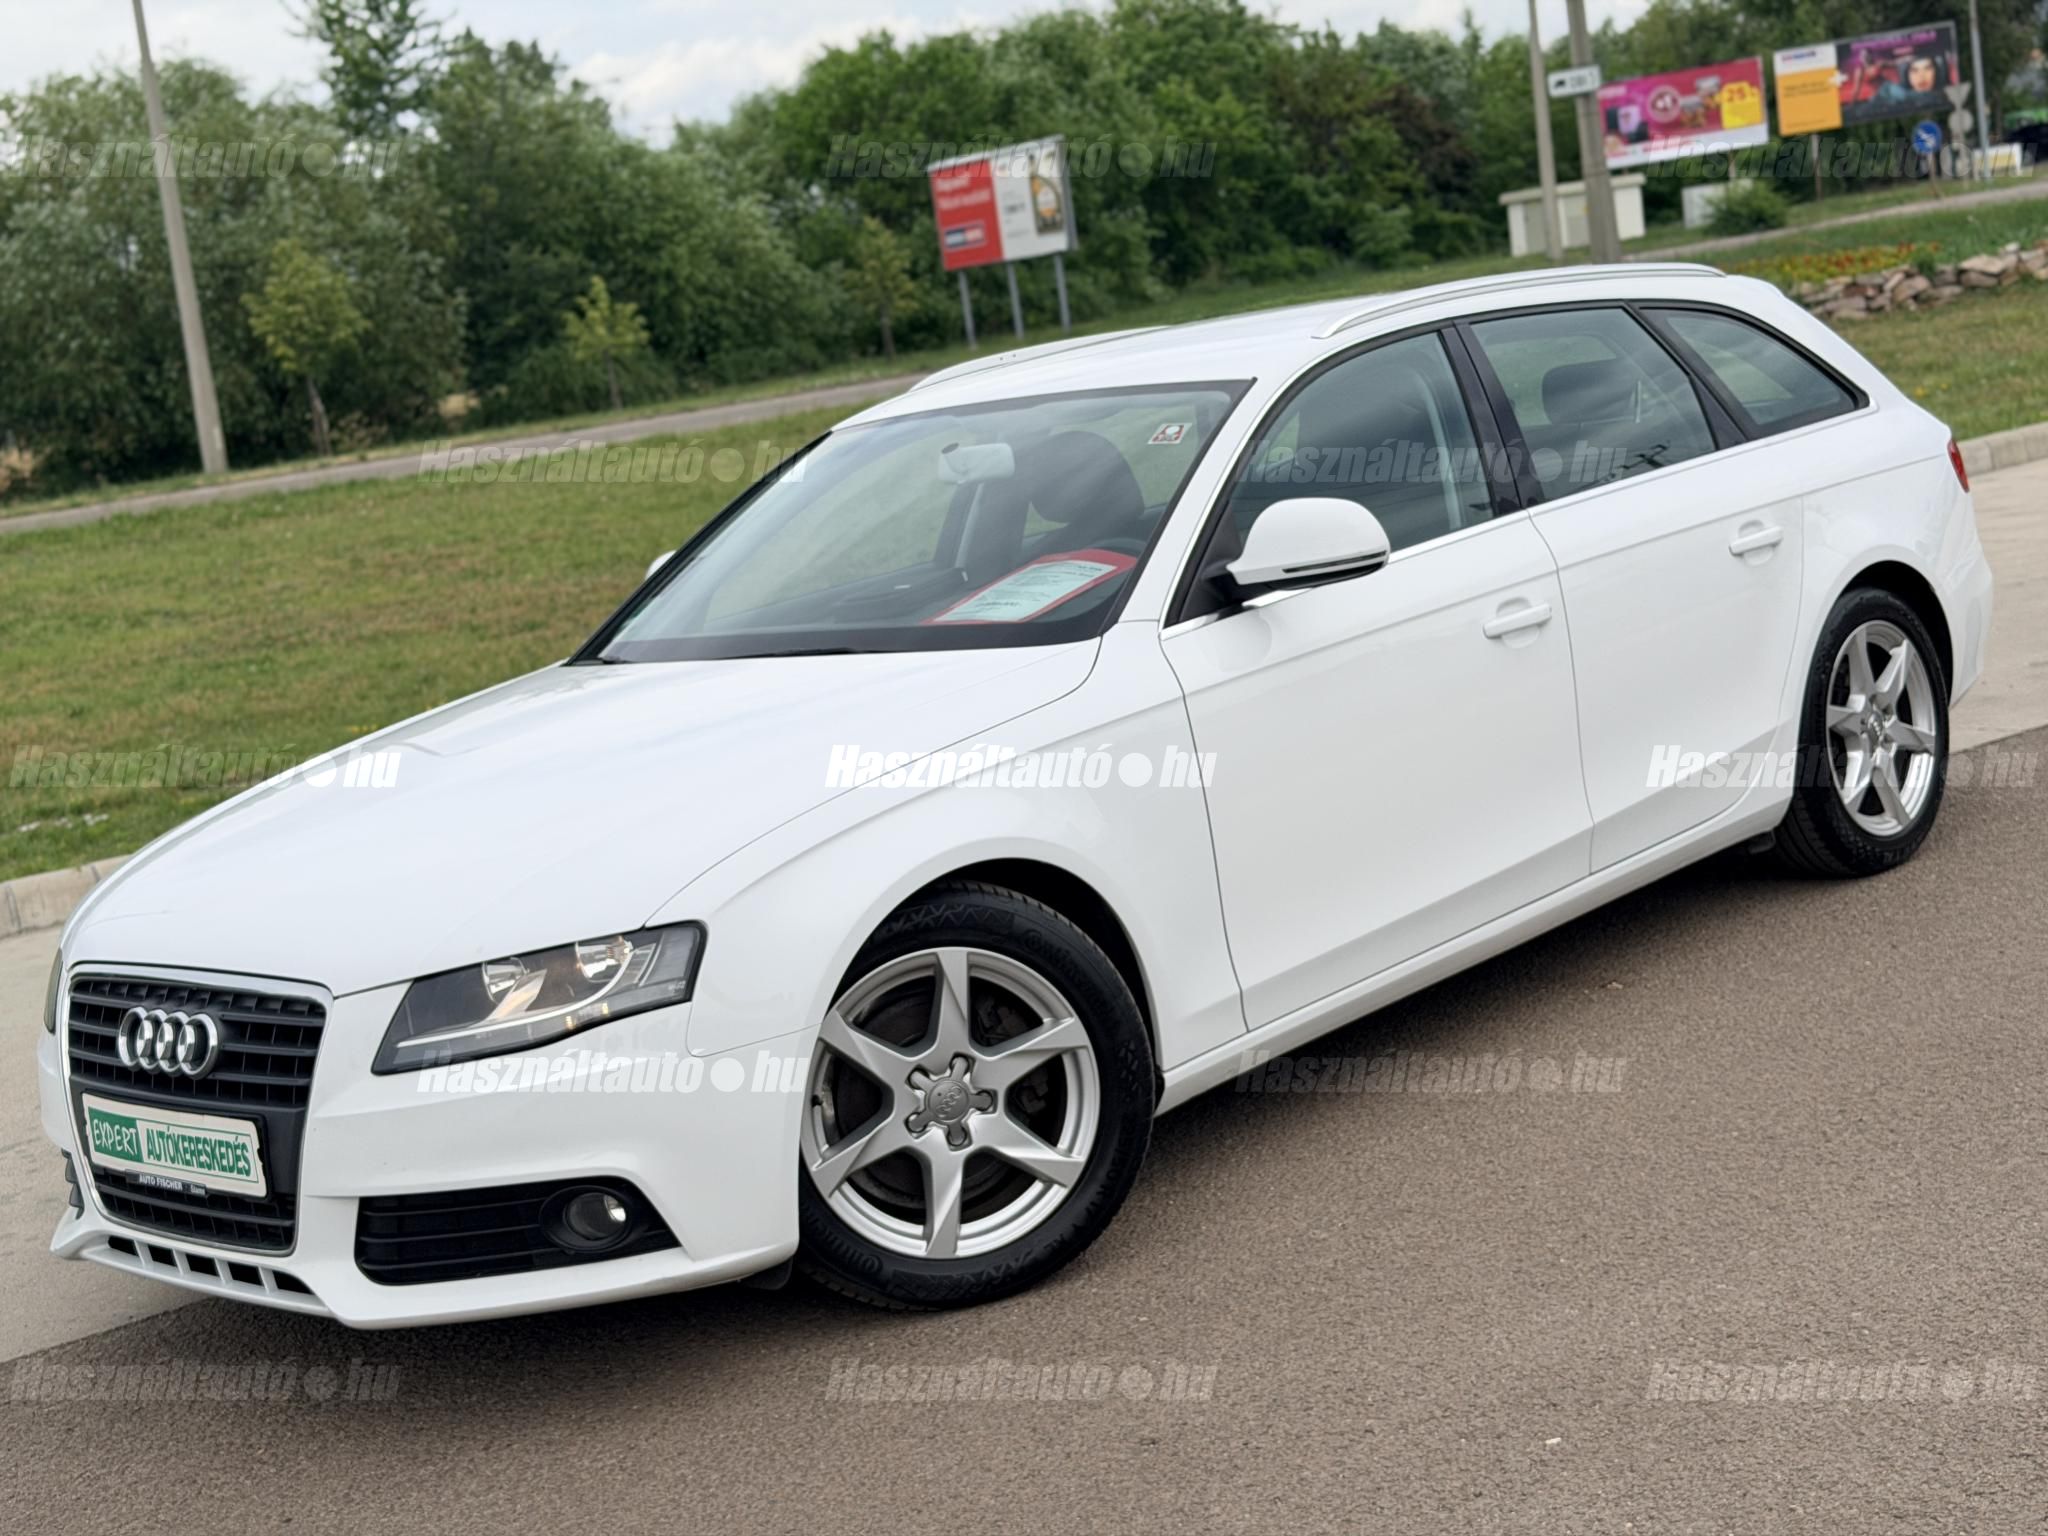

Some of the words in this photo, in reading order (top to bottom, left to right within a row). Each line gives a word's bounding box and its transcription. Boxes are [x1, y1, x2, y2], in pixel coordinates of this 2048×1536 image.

[93, 1118, 138, 1156] EXPERT
[146, 1125, 252, 1177] AUTÓKERESKEDÉS
[138, 1174, 156, 1185] AUTO
[156, 1177, 183, 1191] FISCHER
